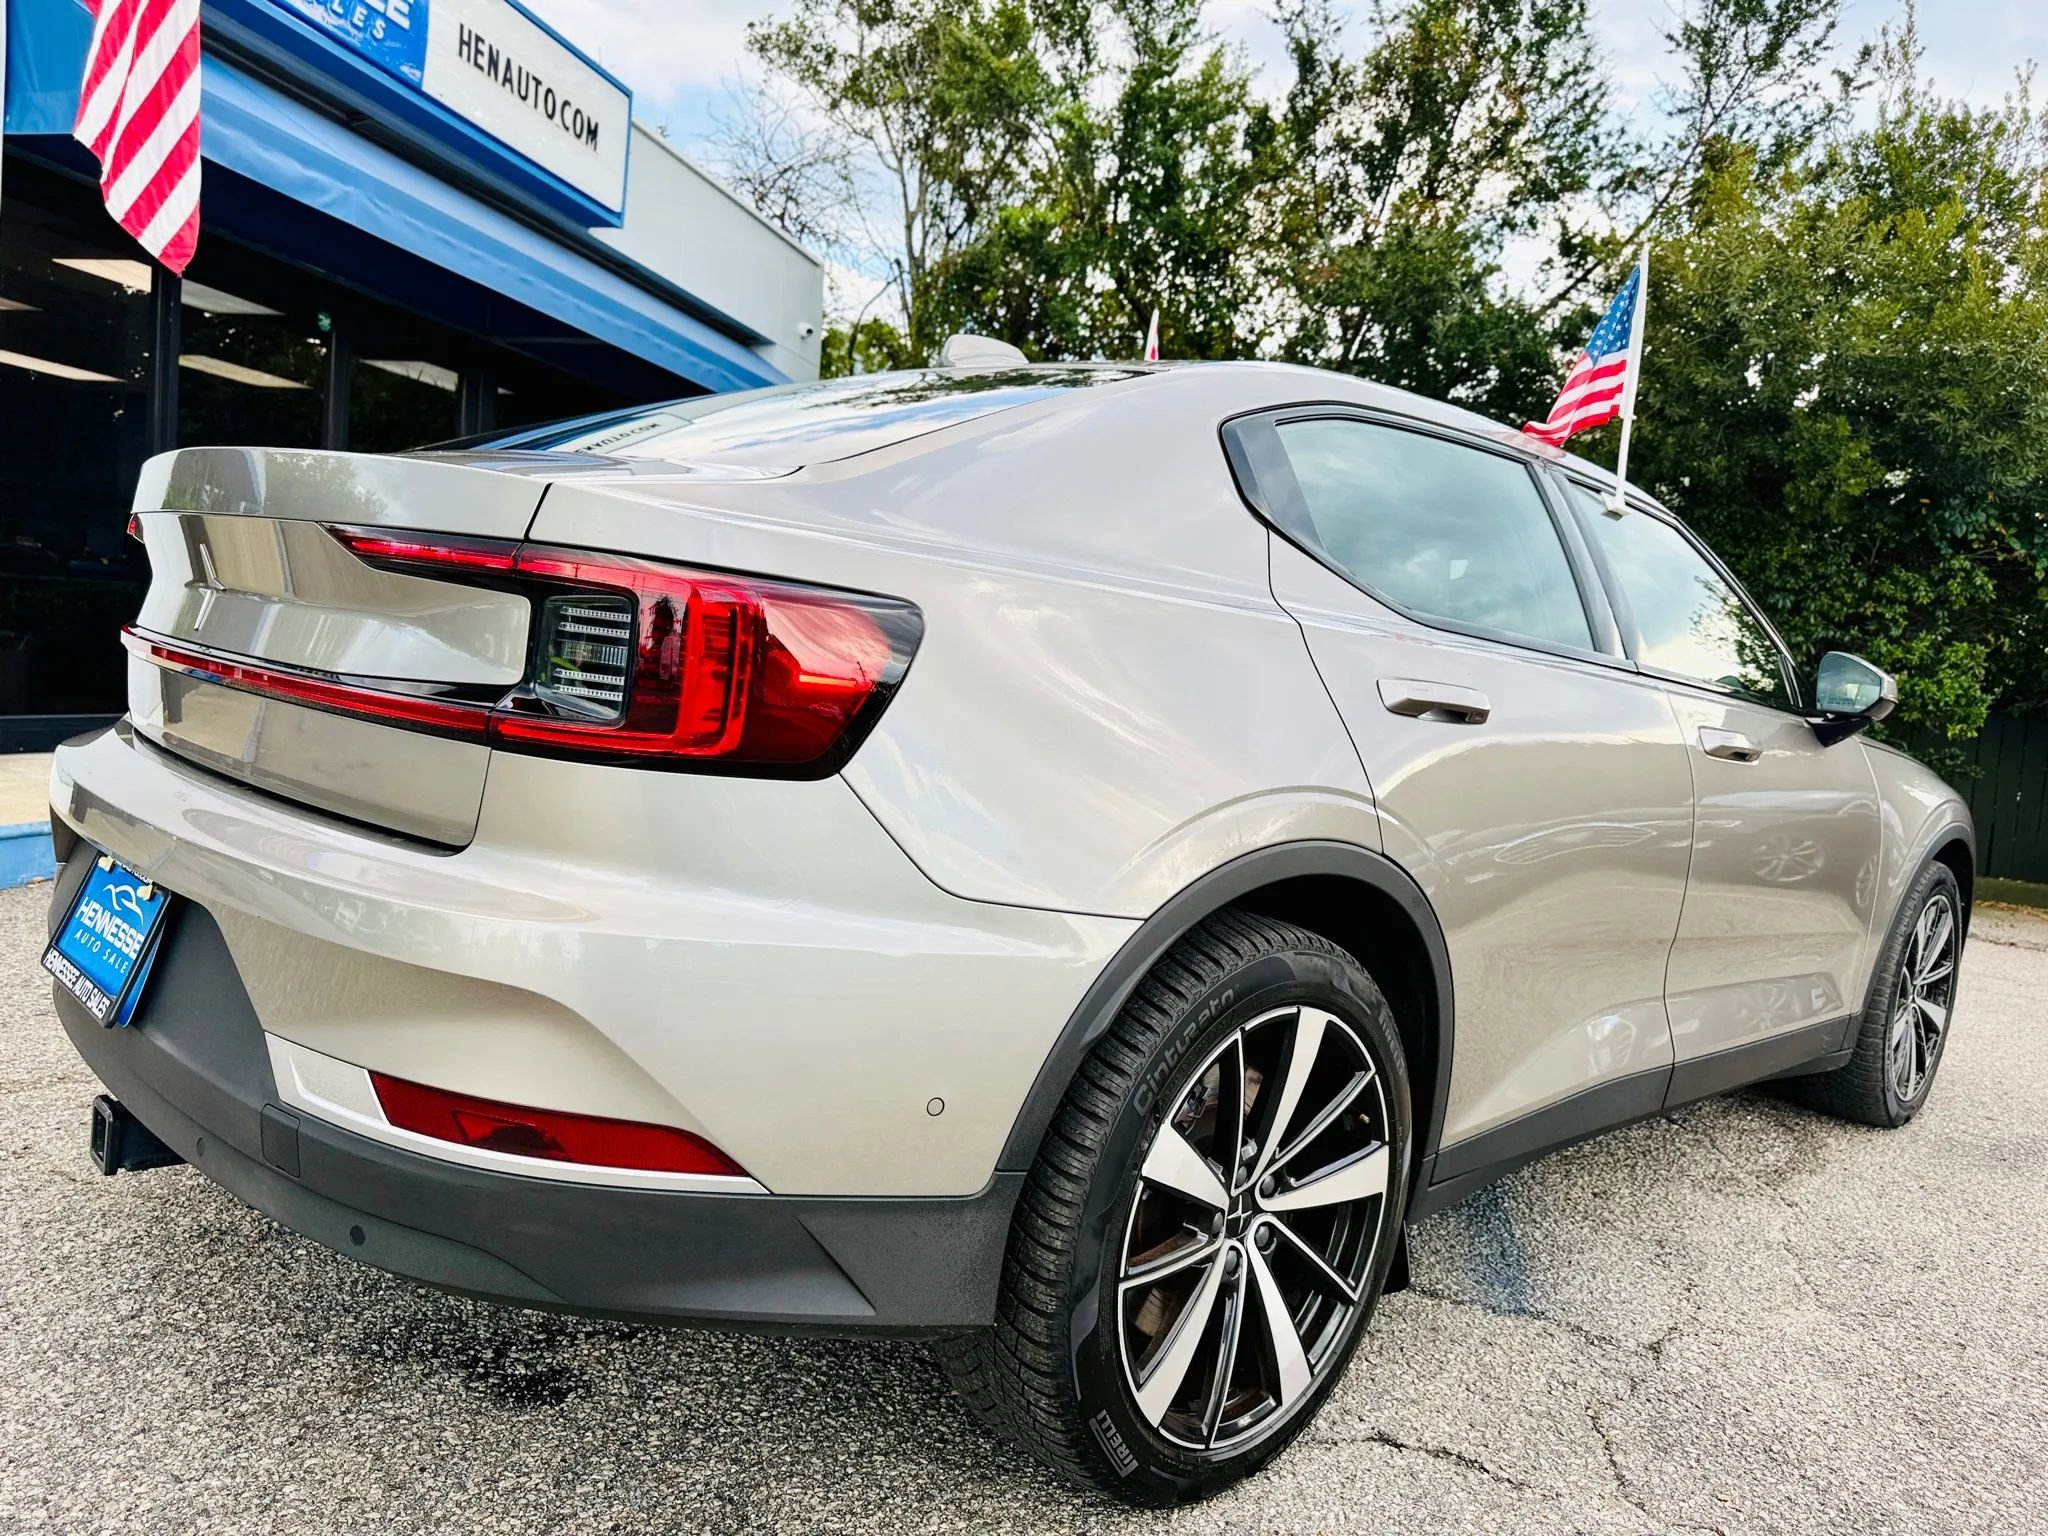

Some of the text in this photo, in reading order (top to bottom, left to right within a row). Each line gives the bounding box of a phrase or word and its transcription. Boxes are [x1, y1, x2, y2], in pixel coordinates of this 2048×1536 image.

[74, 928, 101, 953] AUTO
[43, 947, 111, 1020] HENNESSEE AUTO SALES
[1133, 987, 1236, 1117] Cinturato
[1089, 1409, 1140, 1478] PIRELLI
